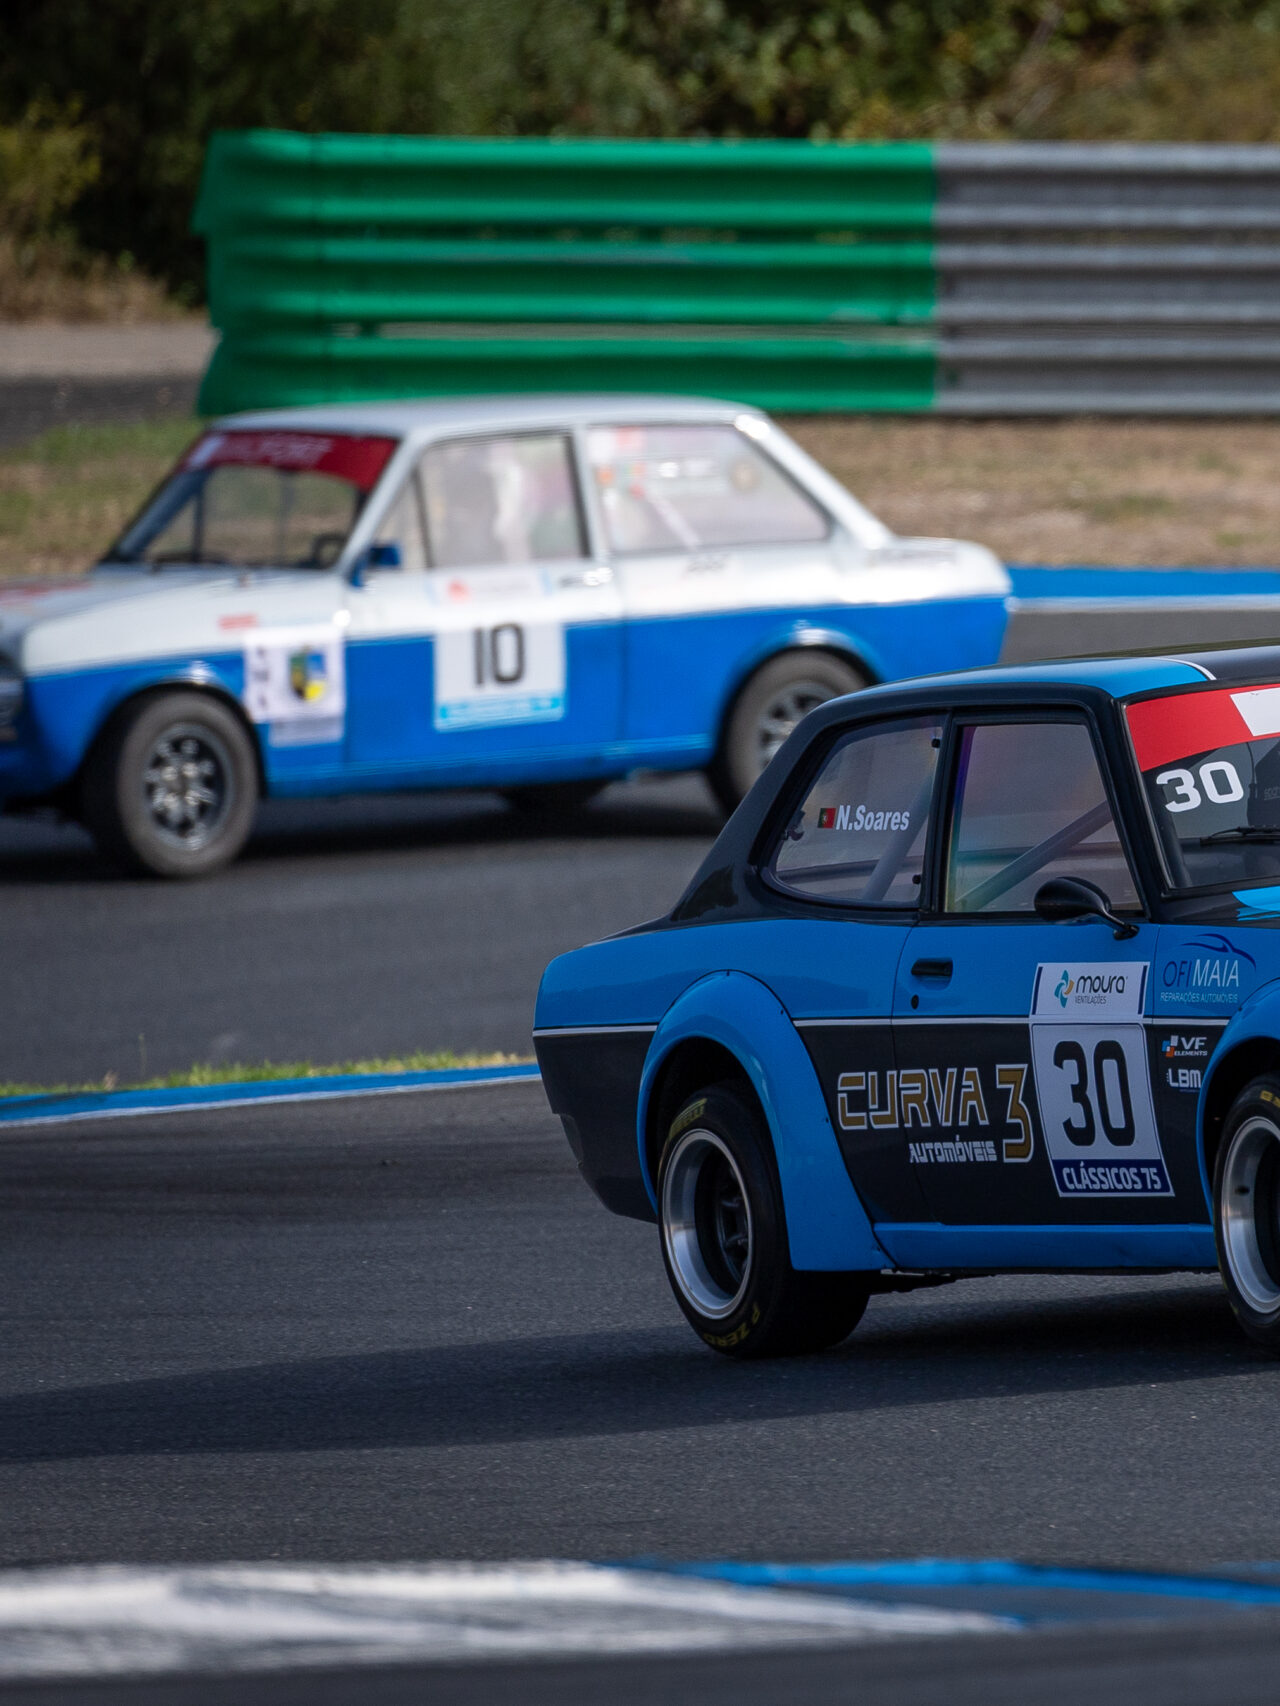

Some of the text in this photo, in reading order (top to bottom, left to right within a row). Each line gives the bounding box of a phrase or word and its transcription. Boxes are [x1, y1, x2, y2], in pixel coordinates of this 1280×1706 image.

[473, 622, 524, 688] 10
[1155, 760, 1245, 814] 30
[835, 804, 911, 832] N.Soares
[1075, 975, 1126, 994] moura
[1180, 1036, 1208, 1050] VF
[1167, 1067, 1202, 1089] LBM
[1053, 1039, 1136, 1147] 30
[837, 1063, 1035, 1163] CURVA 3
[909, 1134, 998, 1164] AUTOMÓVEIS
[1062, 1161, 1162, 1190] CLÁSSICOS 75
